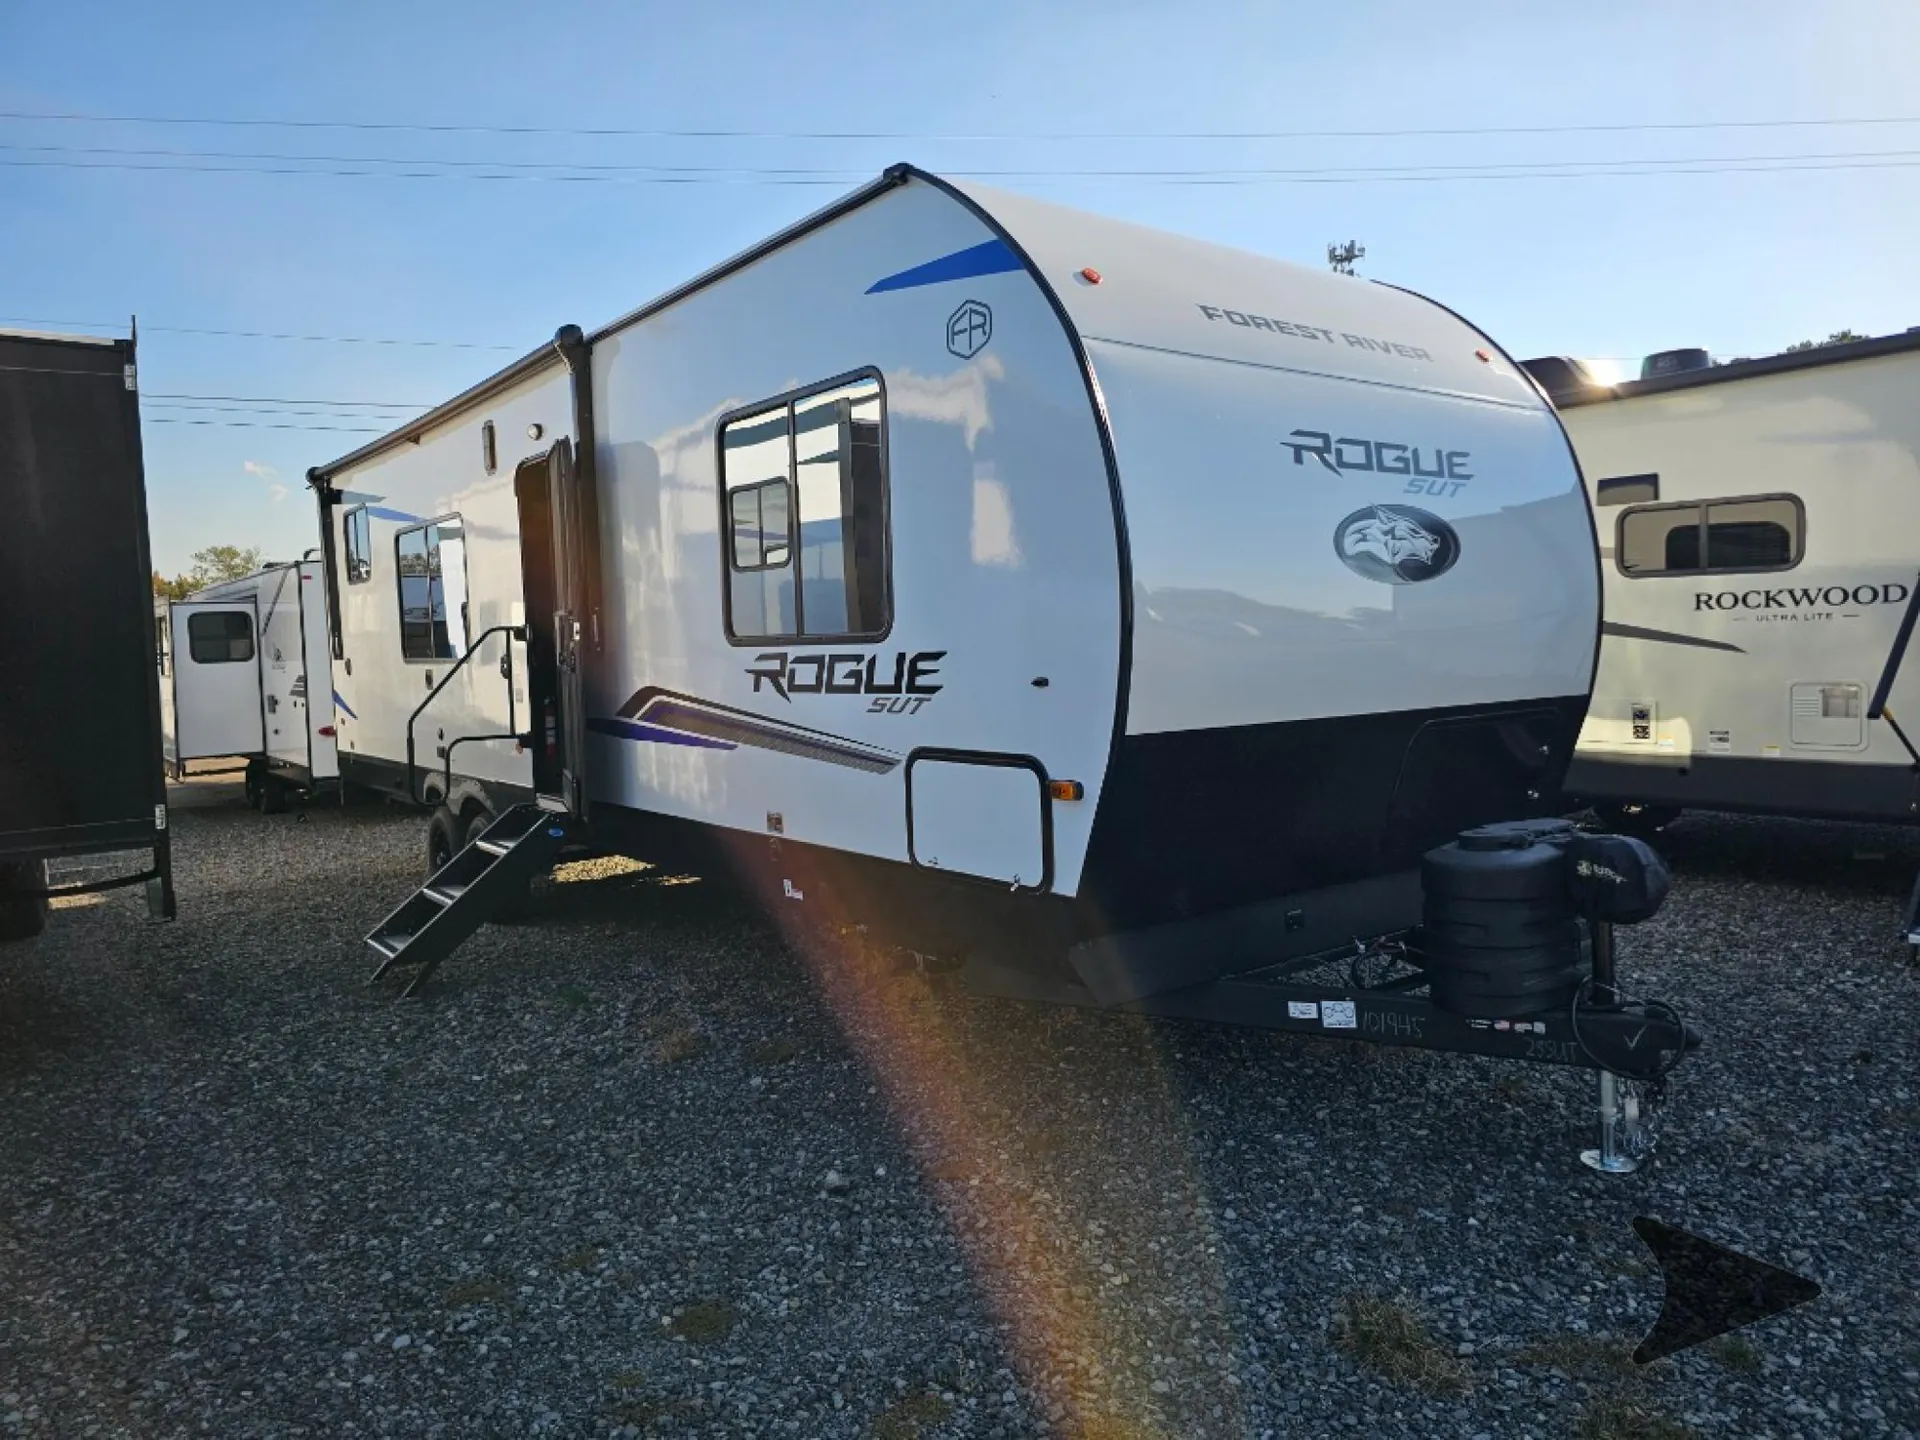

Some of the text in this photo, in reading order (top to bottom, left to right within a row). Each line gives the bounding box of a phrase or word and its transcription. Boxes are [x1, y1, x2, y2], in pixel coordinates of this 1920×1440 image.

[1197, 304, 1435, 362] FOREST RIVER
[1279, 429, 1475, 480] ROGUE
[1403, 477, 1467, 498] SUT
[1694, 583, 1908, 611] ROCKWOOD
[1756, 612, 1833, 622] ULTRA LITE
[744, 651, 948, 703] ROGUE
[866, 696, 932, 715] SUT
